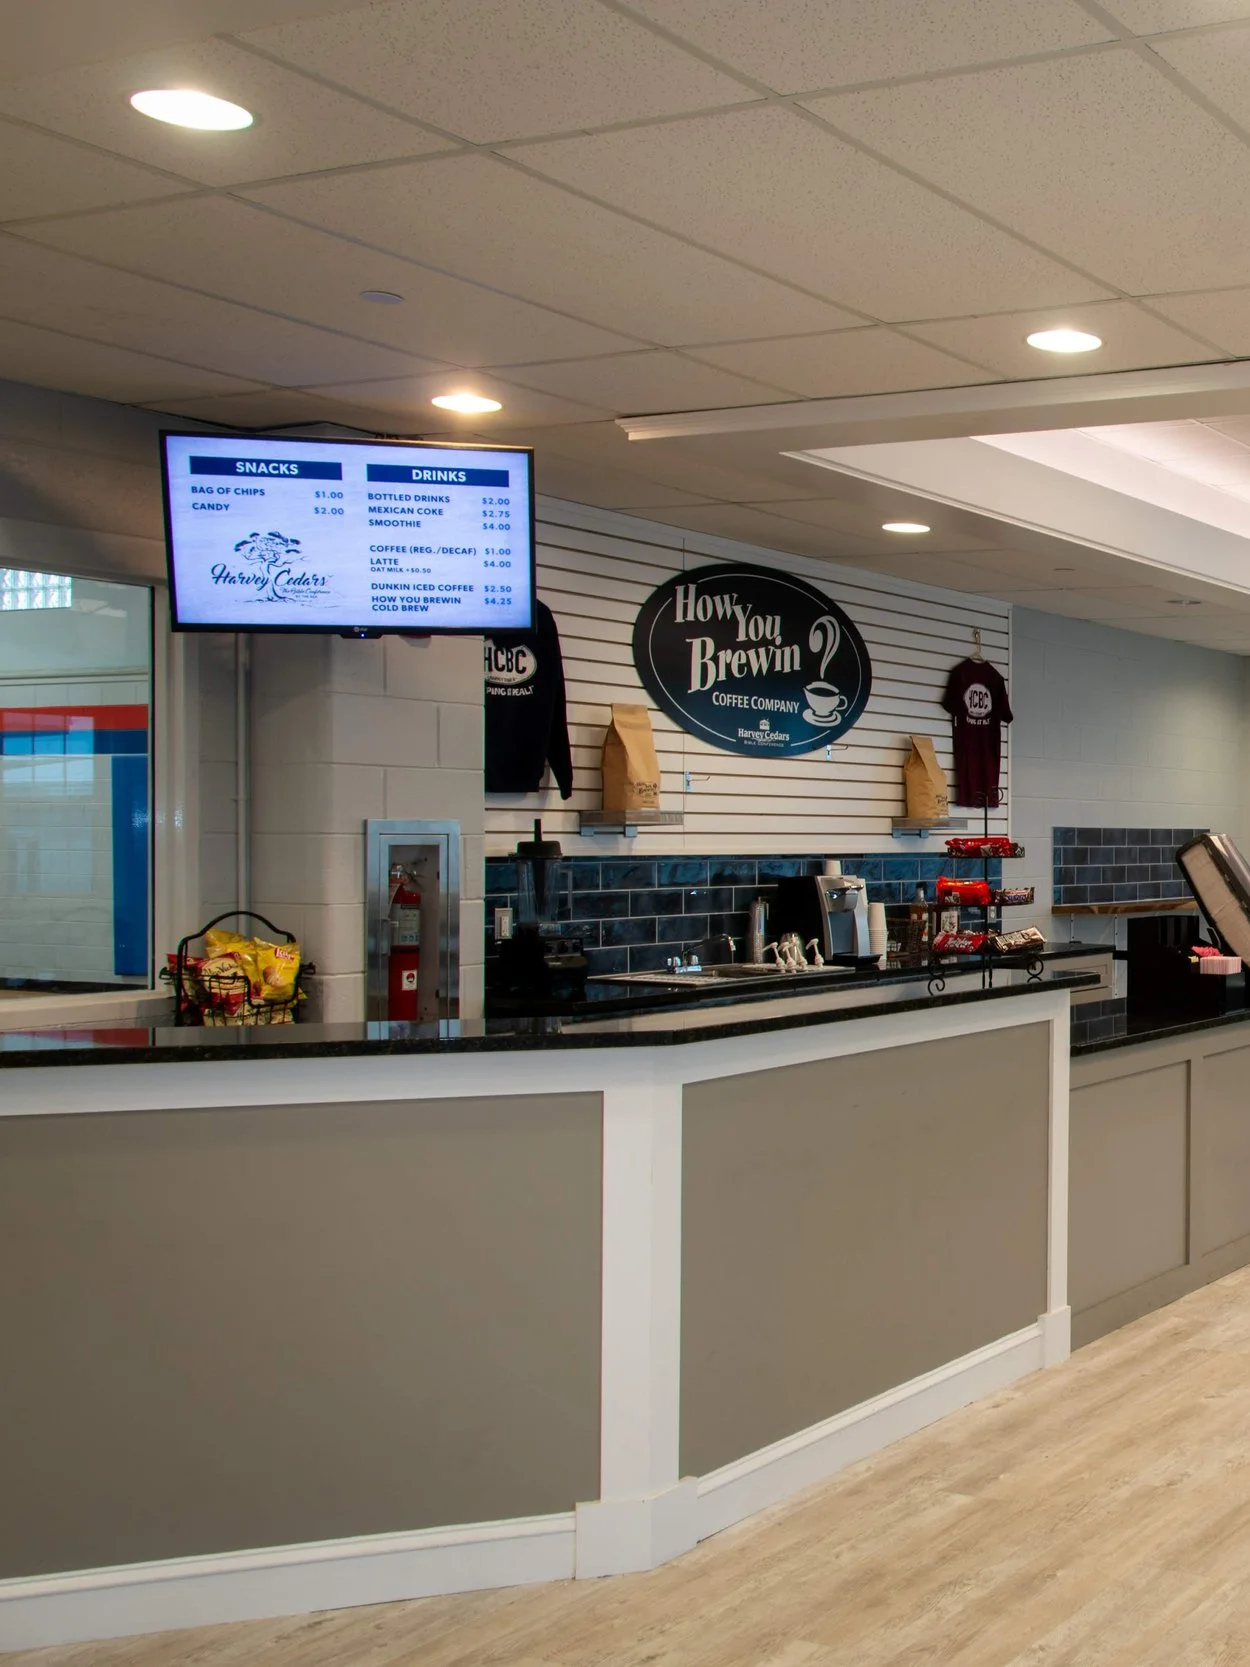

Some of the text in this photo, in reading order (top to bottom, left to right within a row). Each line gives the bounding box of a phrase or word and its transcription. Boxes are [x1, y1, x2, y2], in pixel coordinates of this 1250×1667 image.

[235, 461, 299, 475] SNACKS
[412, 469, 467, 482] DRINKS
[191, 486, 266, 496] BAG OF CHIPS
[314, 490, 344, 499] $1.00
[368, 493, 450, 503] BOTTLED DRINKS
[481, 497, 510, 506] $2.00
[192, 502, 230, 511] CANDY
[314, 507, 345, 515] $2.00
[368, 506, 444, 515] MEXICAN COKE
[482, 510, 510, 518] $2.75
[368, 519, 421, 528] SMOOTHIE
[482, 523, 511, 531] $4.00
[369, 545, 477, 556] COFFEE (REG./DECAF)
[484, 548, 511, 556] $1.00
[483, 560, 512, 568] $4.00
[210, 563, 328, 591] Harvey Cedars
[371, 583, 410, 591] DUNKIN
[437, 584, 474, 592] COFFEE
[484, 585, 512, 593] $2.50
[371, 596, 397, 604] HOW
[399, 596, 421, 604] YOU
[484, 597, 512, 605] $4.25
[674, 583, 738, 623] How
[372, 604, 399, 612] COLD
[733, 603, 781, 642] You
[484, 647, 527, 674] HCBC
[686, 634, 802, 694] Brewin
[712, 691, 800, 714] COFFEE COMPANY
[738, 728, 790, 741] Harvey Cedars
